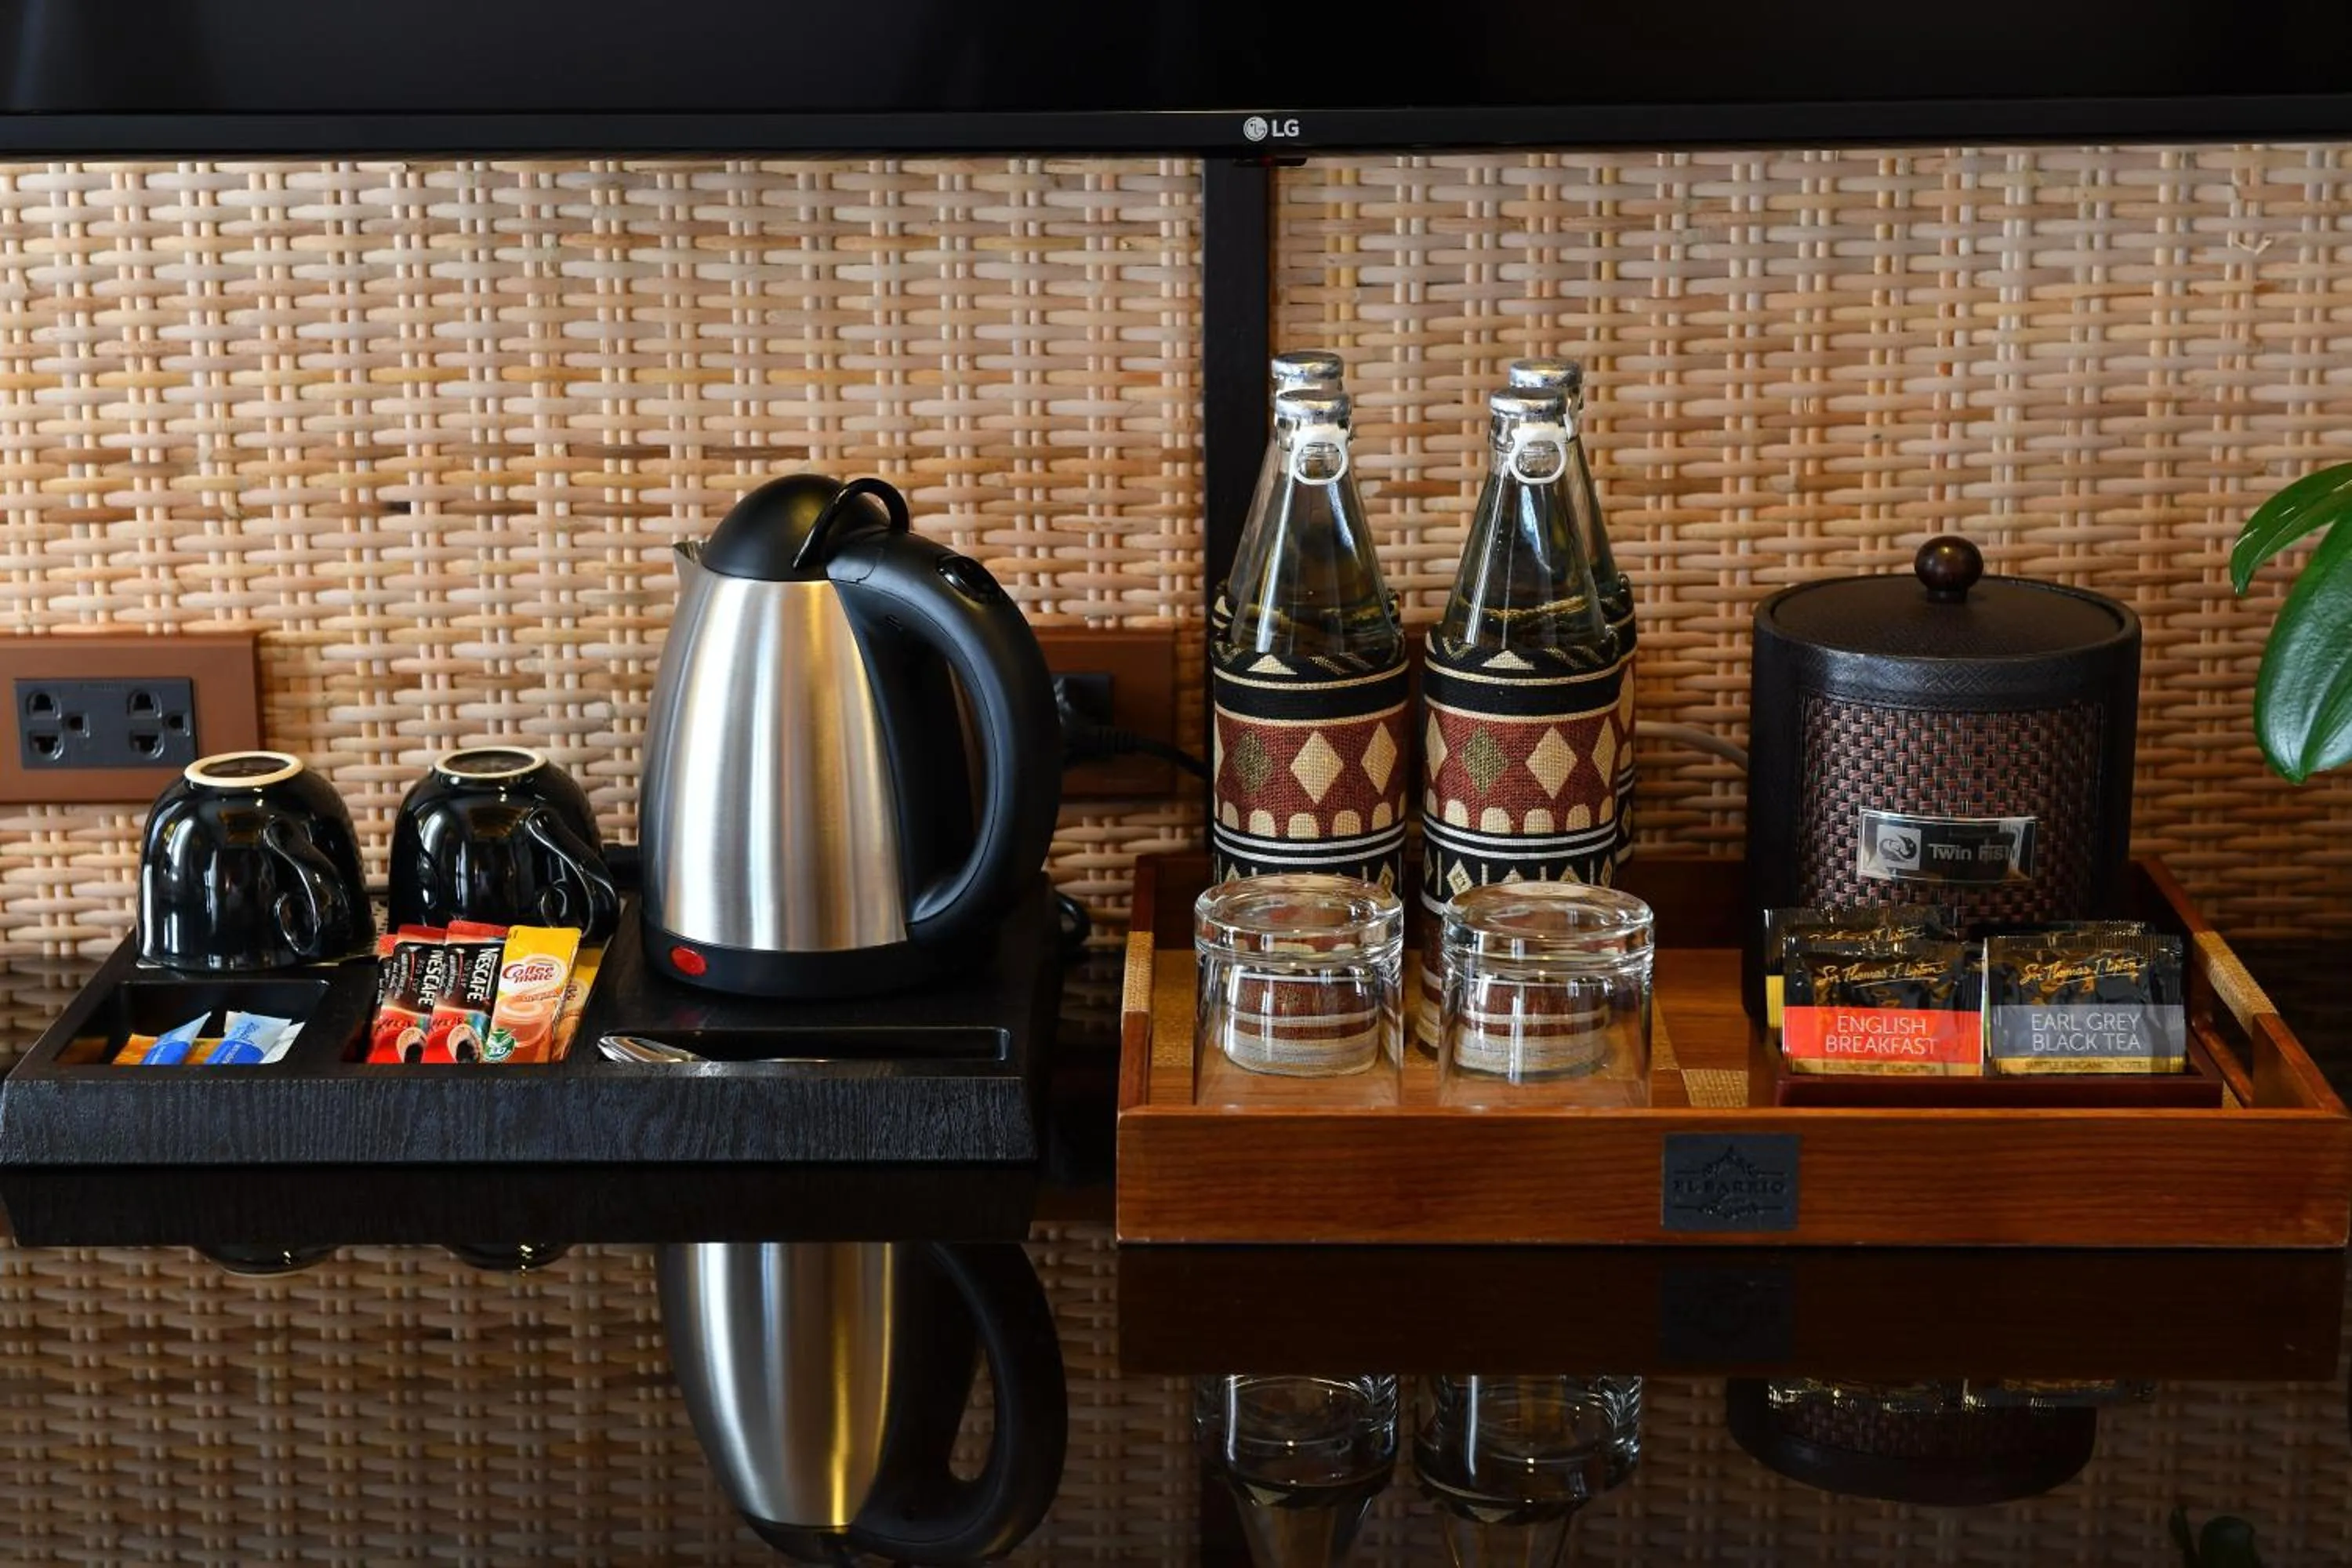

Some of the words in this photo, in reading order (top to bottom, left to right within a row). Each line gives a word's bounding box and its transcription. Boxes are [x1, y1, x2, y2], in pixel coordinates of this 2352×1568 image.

[1271, 118, 1300, 137] LG
[1928, 843, 1972, 861] Twin
[1837, 1015, 1926, 1035] ENGLISH
[2031, 1013, 2082, 1032] EARL
[2086, 1012, 2141, 1031] GREY
[1824, 1033, 1938, 1055] BREAKFAST
[2032, 1033, 2097, 1051] BLACK
[2103, 1033, 2142, 1051] TEA
